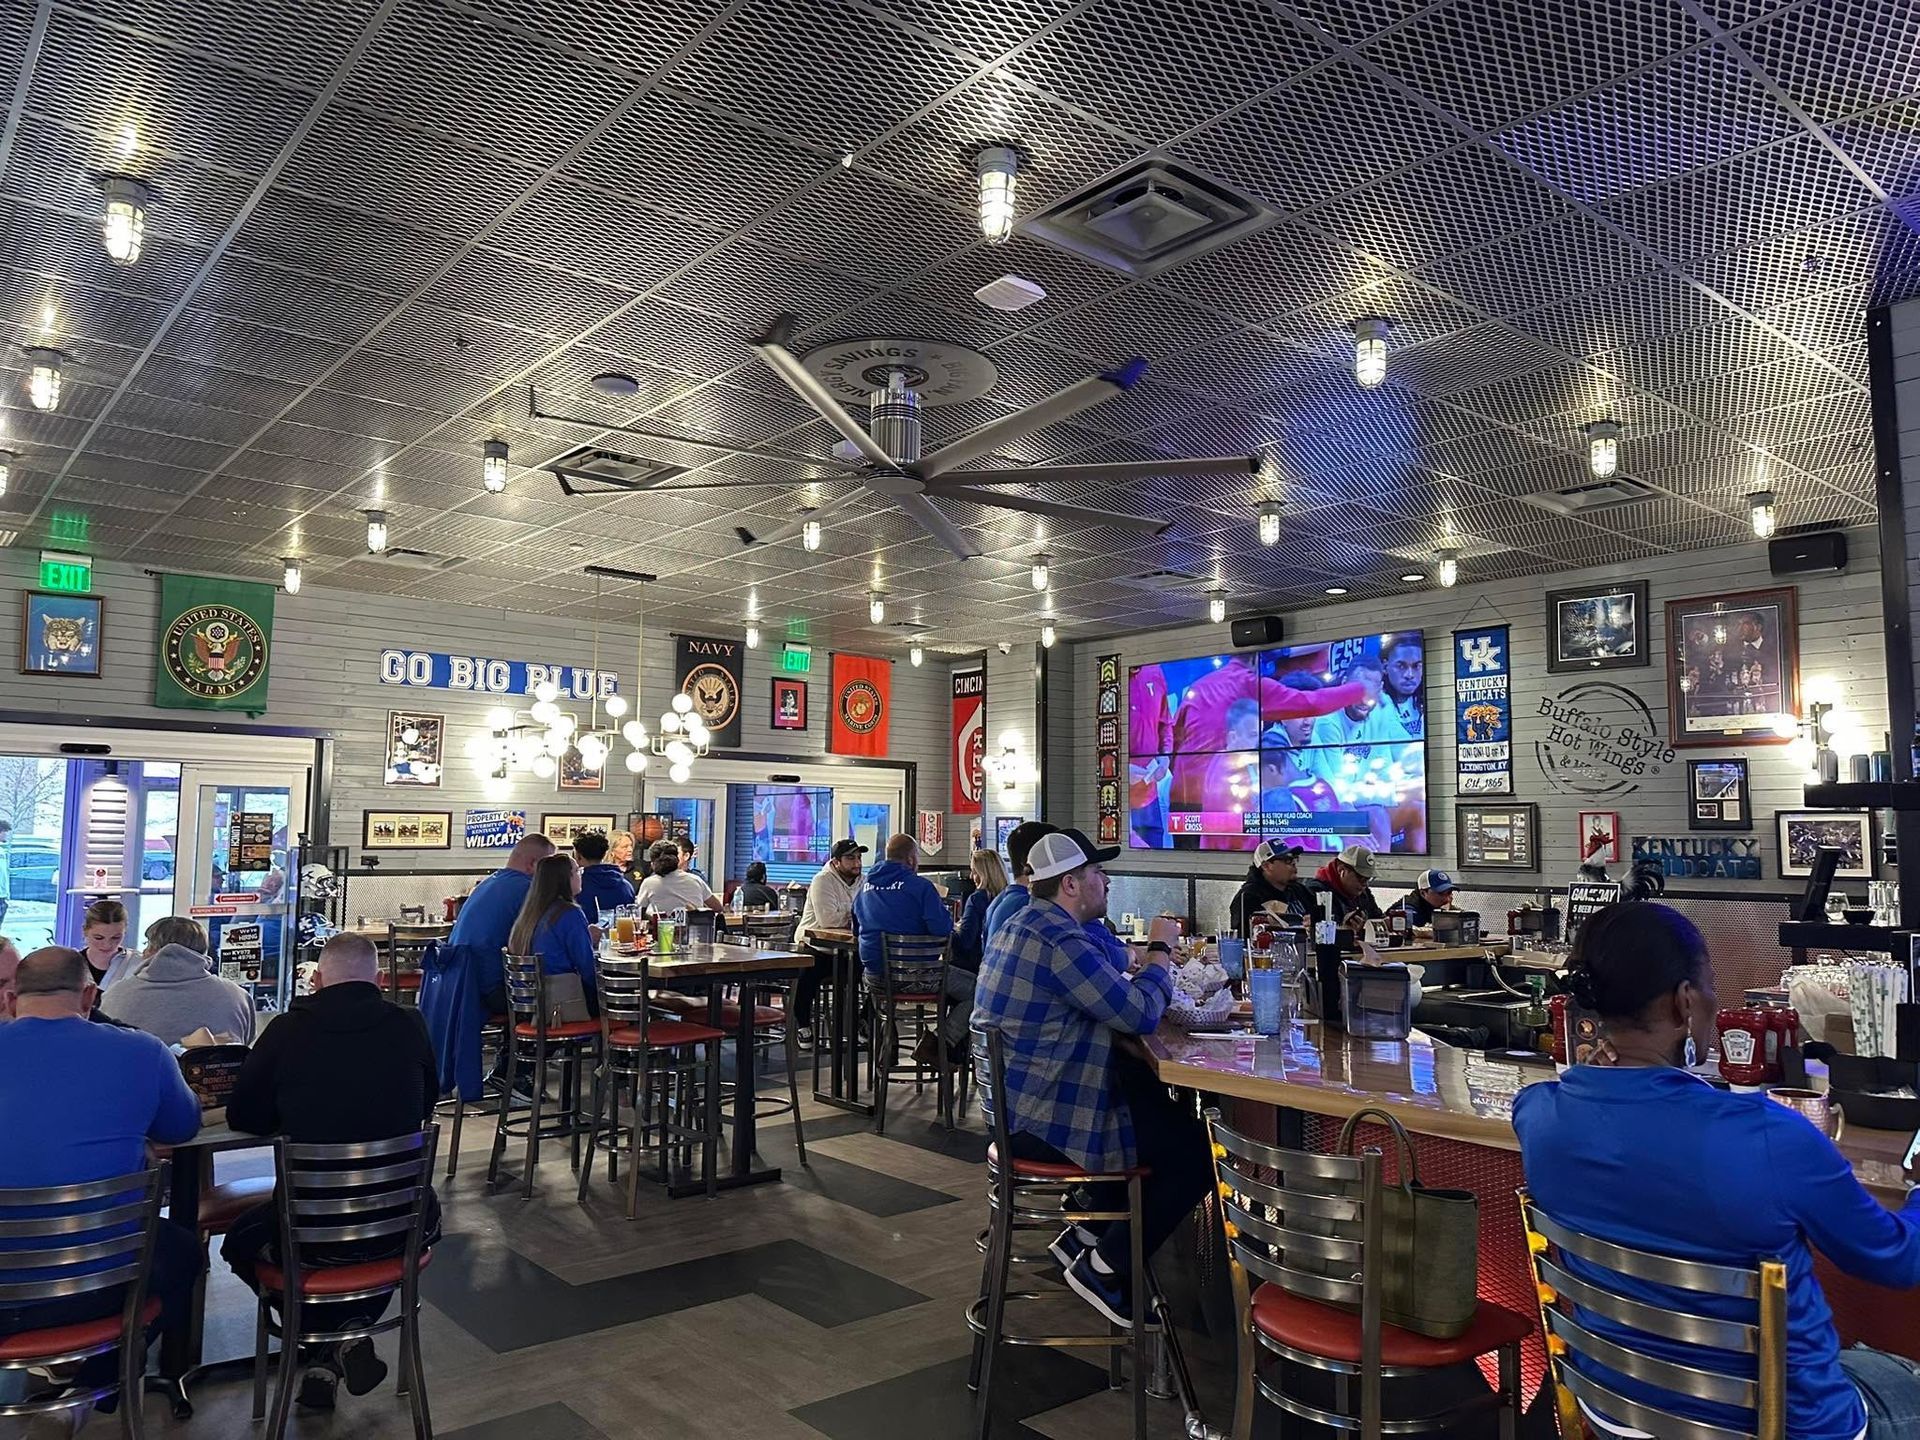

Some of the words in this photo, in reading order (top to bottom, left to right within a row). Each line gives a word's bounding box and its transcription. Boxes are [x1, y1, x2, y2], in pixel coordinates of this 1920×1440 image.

[824, 347, 919, 370] SAVINGS
[820, 372, 871, 398] NERGY
[47, 563, 86, 591] EXIT
[173, 609, 218, 636] UNITED
[220, 609, 261, 643] STATES
[688, 641, 735, 657] NAVY
[1460, 636, 1501, 673] UK
[786, 652, 808, 672] EXIT
[380, 650, 433, 686] GO
[449, 656, 511, 693] BIG
[525, 663, 619, 699] BLUE
[192, 682, 236, 695] ARMY
[1458, 675, 1506, 691] KENTUCKY
[844, 684, 864, 699] UNITED
[1459, 688, 1506, 703] WILDCATS
[844, 713, 863, 730] MARINE
[1536, 697, 1612, 739] Buffalo
[1617, 728, 1676, 764] Style
[1547, 723, 1582, 751] Hot
[1588, 738, 1646, 776] Wings
[1559, 755, 1571, 768] &
[467, 813, 502, 823] PROPERTY
[467, 822, 497, 830] UNIVERSITY
[1184, 815, 1201, 823] SCOTT
[466, 832, 523, 848] WILDCATS
[1632, 837, 1759, 858] KENTUCKY
[1660, 858, 1758, 878] ILDCATS
[1571, 887, 1617, 902] GAMEDAY
[676, 909, 685, 923] 20
[1572, 904, 1578, 912] 5
[1577, 904, 1592, 913] BEER
[1125, 914, 1131, 924] 3
